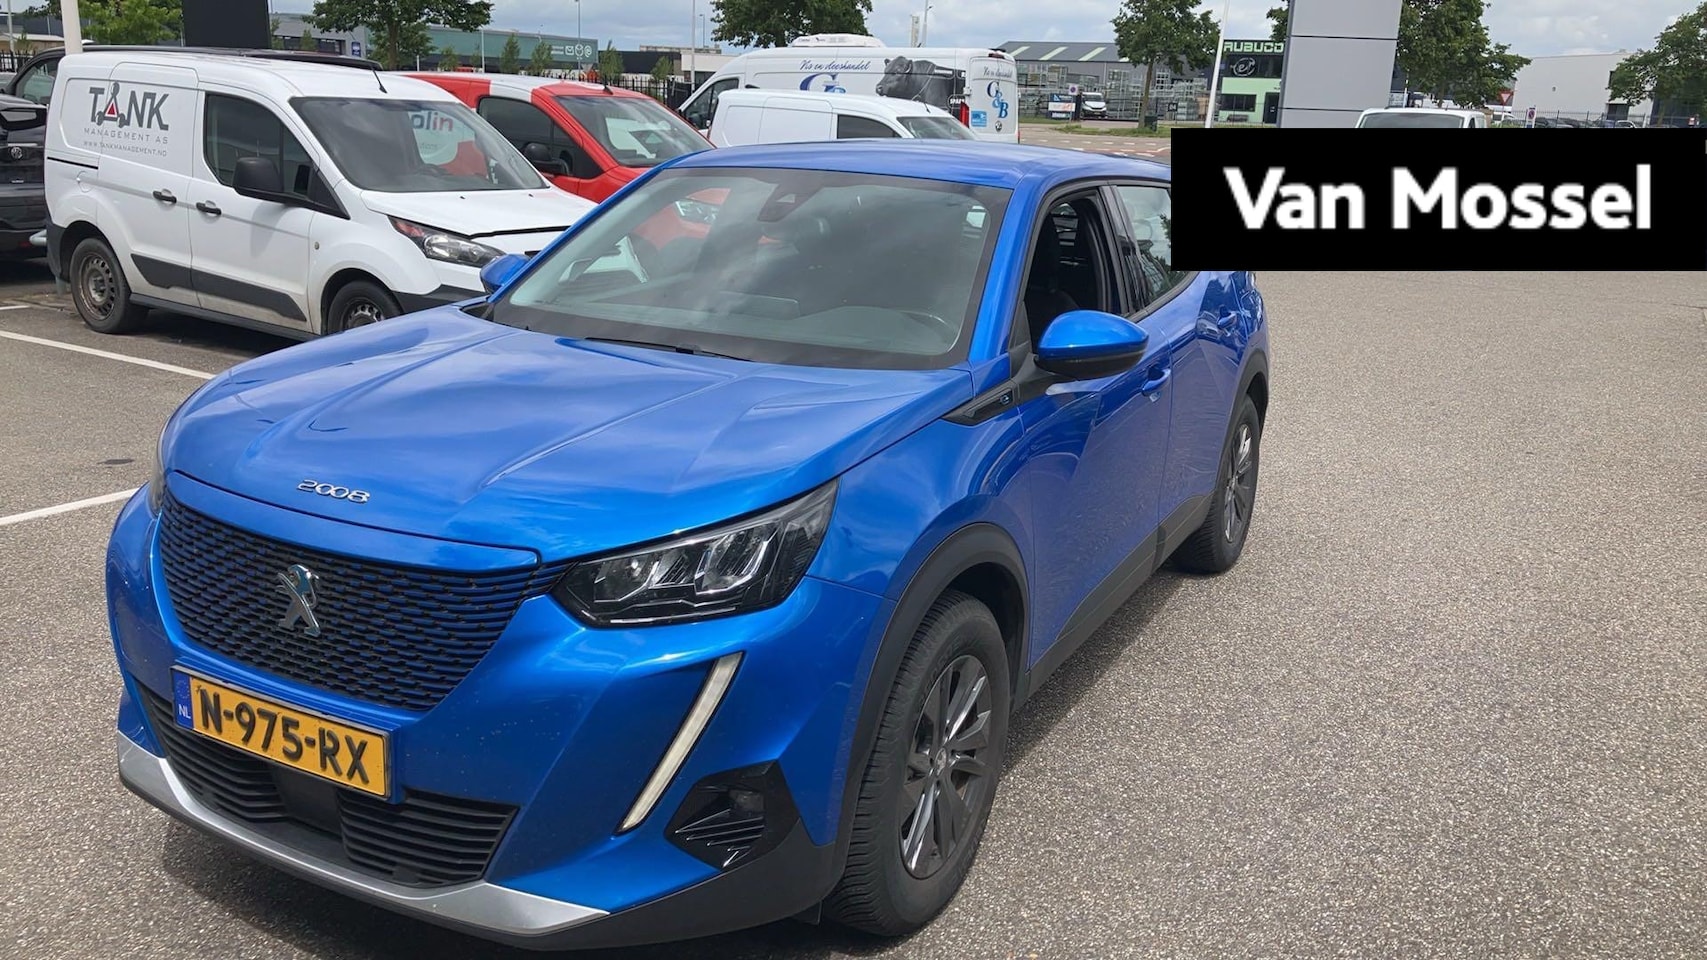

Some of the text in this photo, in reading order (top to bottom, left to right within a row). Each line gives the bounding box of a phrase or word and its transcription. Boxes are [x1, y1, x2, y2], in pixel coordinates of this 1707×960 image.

[89, 82, 169, 131] TANK
[84, 128, 168, 144] MANAGEMENT AS
[297, 479, 371, 504] 2008
[178, 703, 191, 719] NL
[200, 688, 370, 784] N-975-RX
